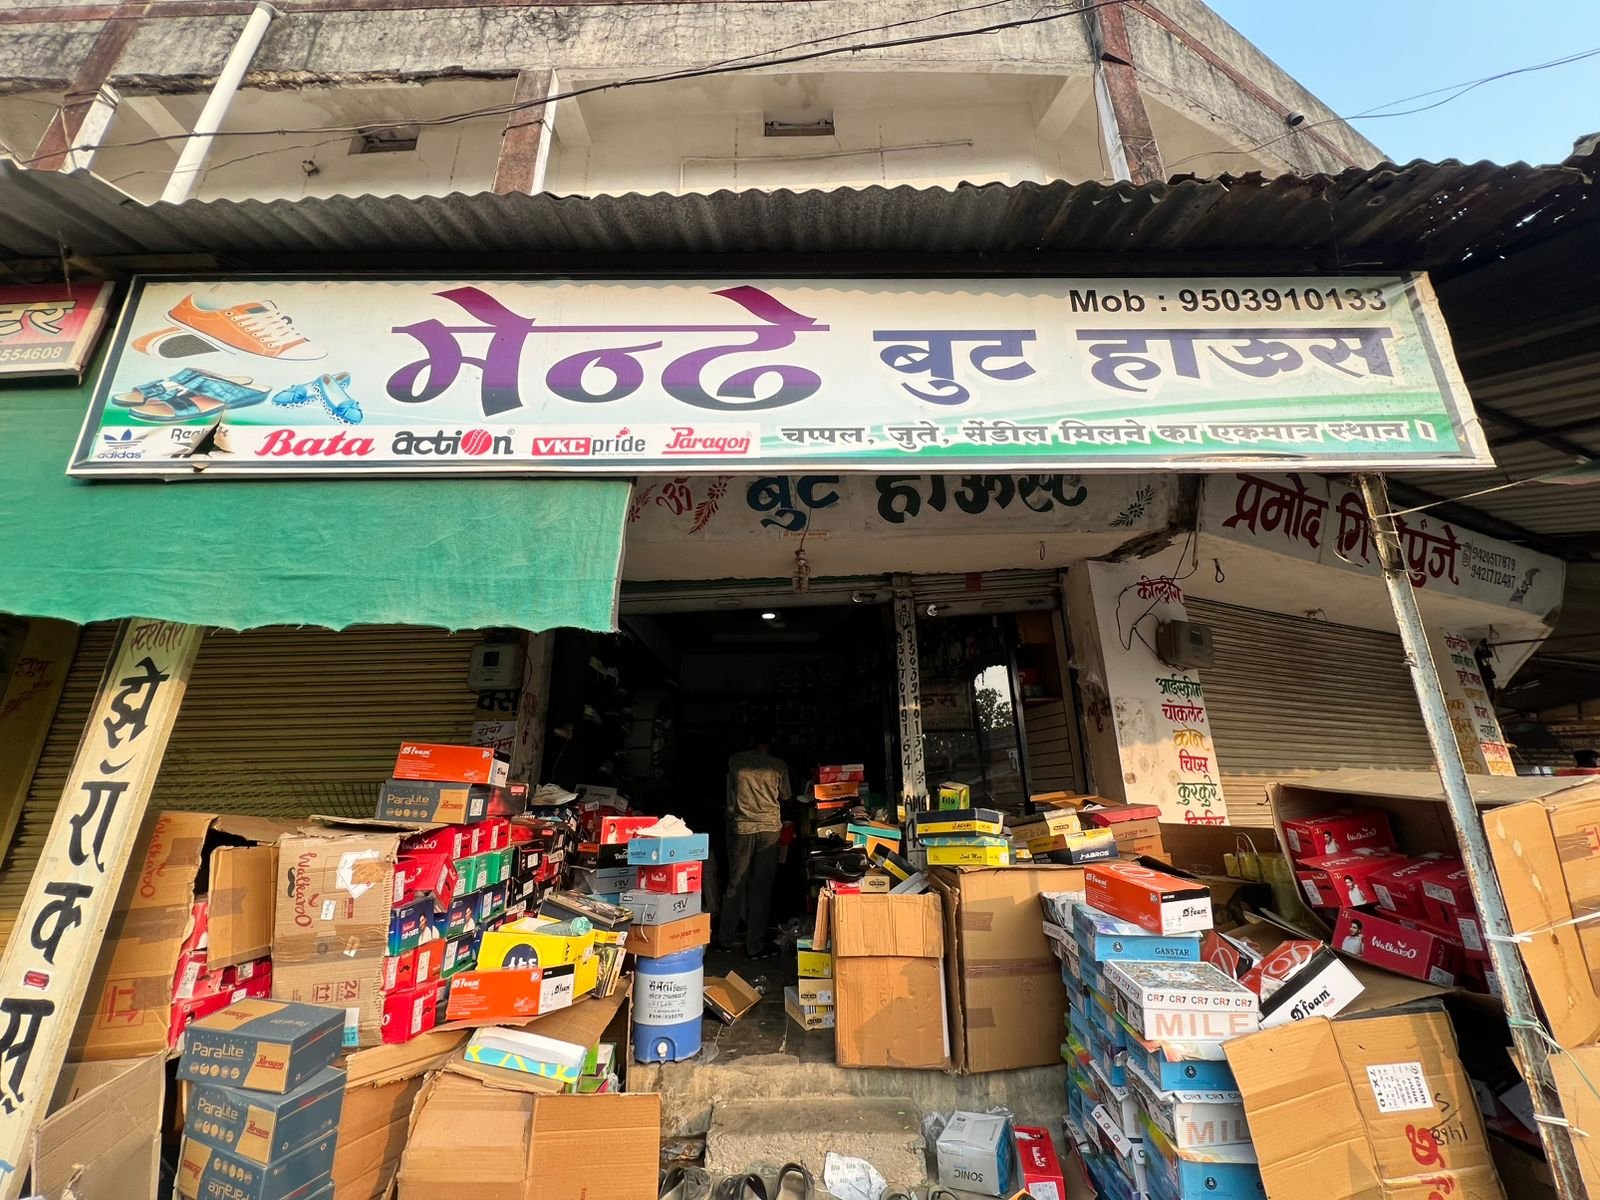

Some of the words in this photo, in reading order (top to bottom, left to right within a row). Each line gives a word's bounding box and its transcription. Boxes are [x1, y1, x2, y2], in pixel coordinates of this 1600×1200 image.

[1071, 290, 1146, 312] Mob
[1178, 288, 1387, 312] 9503910133
[873, 330, 1037, 405] बुट
[1076, 328, 1394, 392] हाऊस
[254, 429, 376, 456] Bata
[537, 438, 589, 455] VKC
[592, 430, 646, 454] pride
[662, 427, 751, 454] Paragon
[1060, 419, 1145, 443] मिलने
[1158, 424, 1202, 442] का
[1208, 423, 1318, 442] एकमात्र
[1328, 420, 1406, 441] स्थान
[97, 450, 142, 460] adidas
[1222, 473, 1330, 549] प्रमोद
[387, 793, 430, 805] ParaLite
[1154, 947, 1190, 957] GANSTAR
[343, 980, 358, 1000] 24
[1147, 993, 1165, 1002] CR7
[1169, 995, 1187, 1004] CR7
[1191, 996, 1209, 1005] CR7
[1213, 997, 1230, 1006] CR7
[1234, 998, 1252, 1007] CR7
[1155, 1013, 1250, 1037] MILE
[192, 1042, 244, 1058] ParaLite
[197, 1097, 238, 1120] ParaLite
[953, 1168, 984, 1183] SONIC
